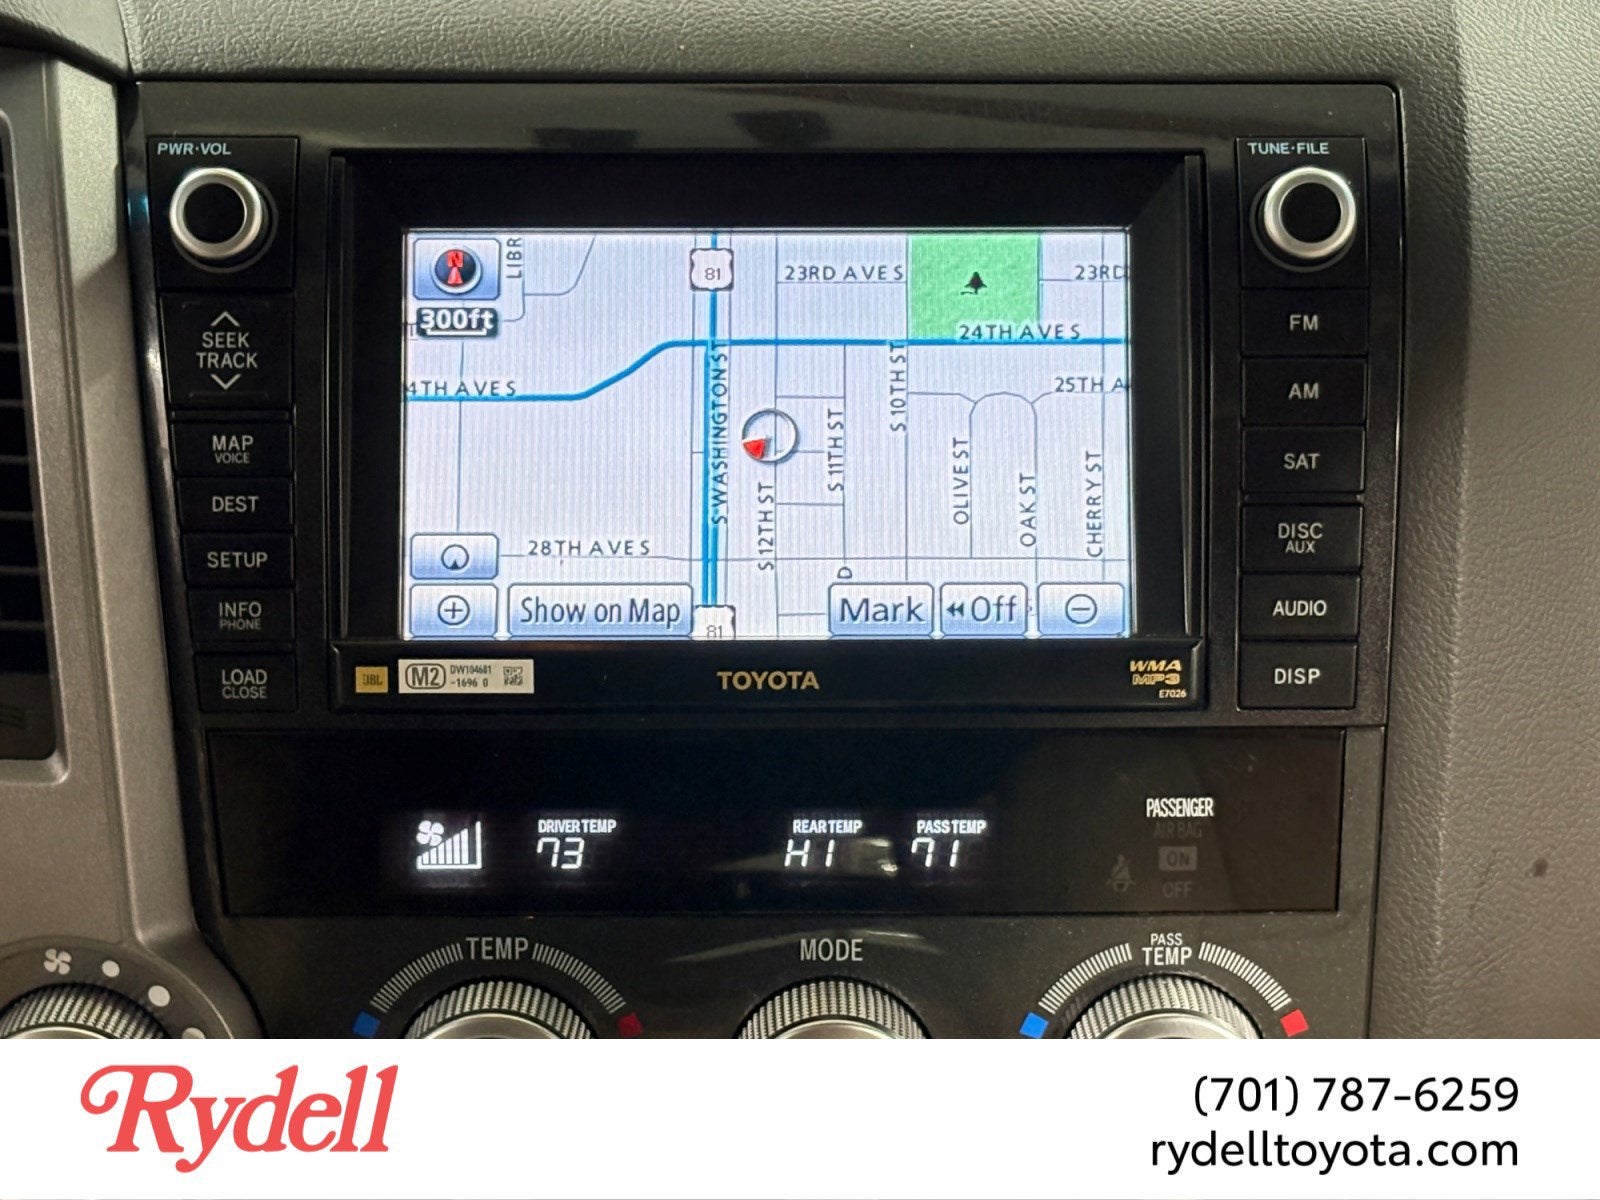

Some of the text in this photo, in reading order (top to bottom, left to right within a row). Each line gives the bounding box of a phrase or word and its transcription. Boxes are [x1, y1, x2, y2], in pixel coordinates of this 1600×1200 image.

[704, 267, 721, 281] 81
[784, 265, 836, 281] 23RD
[419, 308, 494, 330] 300ft
[1289, 314, 1319, 331] FM
[202, 331, 250, 349] SEEK
[959, 324, 1012, 340] 24TH
[196, 352, 258, 369] TRACK
[890, 370, 906, 415] 10TH
[1054, 377, 1104, 393] 25TH
[1288, 382, 1320, 399] AM
[212, 435, 254, 451] MAP
[711, 369, 728, 508] WASHINGTON
[214, 452, 250, 464] VOICE
[1283, 453, 1321, 470] SAT
[953, 466, 970, 525] OLIVE
[211, 496, 260, 513] DEST
[1020, 502, 1037, 547] OAK
[1086, 479, 1104, 558] CHERRY
[758, 510, 774, 555] 12TH
[1277, 522, 1324, 540] DISC
[528, 540, 581, 556] 28TH
[1285, 540, 1316, 554] AUX
[207, 551, 269, 568] SETUP
[218, 601, 262, 618] INFO
[520, 596, 680, 629] Show on Map
[839, 595, 924, 623] Mark
[970, 594, 1017, 623] Off
[1272, 600, 1327, 617] AUDIO
[219, 618, 262, 630] PHONE
[1129, 659, 1182, 672] WMA
[221, 668, 268, 685] LOAD
[411, 666, 440, 687] M2
[716, 670, 820, 691] TOYOTA
[1132, 673, 1181, 686] MP3
[1273, 668, 1321, 685] DISP
[222, 686, 268, 699] CLOSE
[1146, 797, 1214, 818] PASSENGER
[537, 818, 617, 834] DRIVER TEMP
[792, 818, 863, 834] REAR TEMP
[916, 819, 987, 834] PASS TEMP
[536, 836, 585, 870] 73
[911, 836, 960, 868] 71
[1166, 852, 1191, 867] ON
[1150, 932, 1183, 946] PASS
[466, 936, 529, 960] TEMP
[800, 938, 863, 961] MODE
[1141, 946, 1193, 966] TEMP
